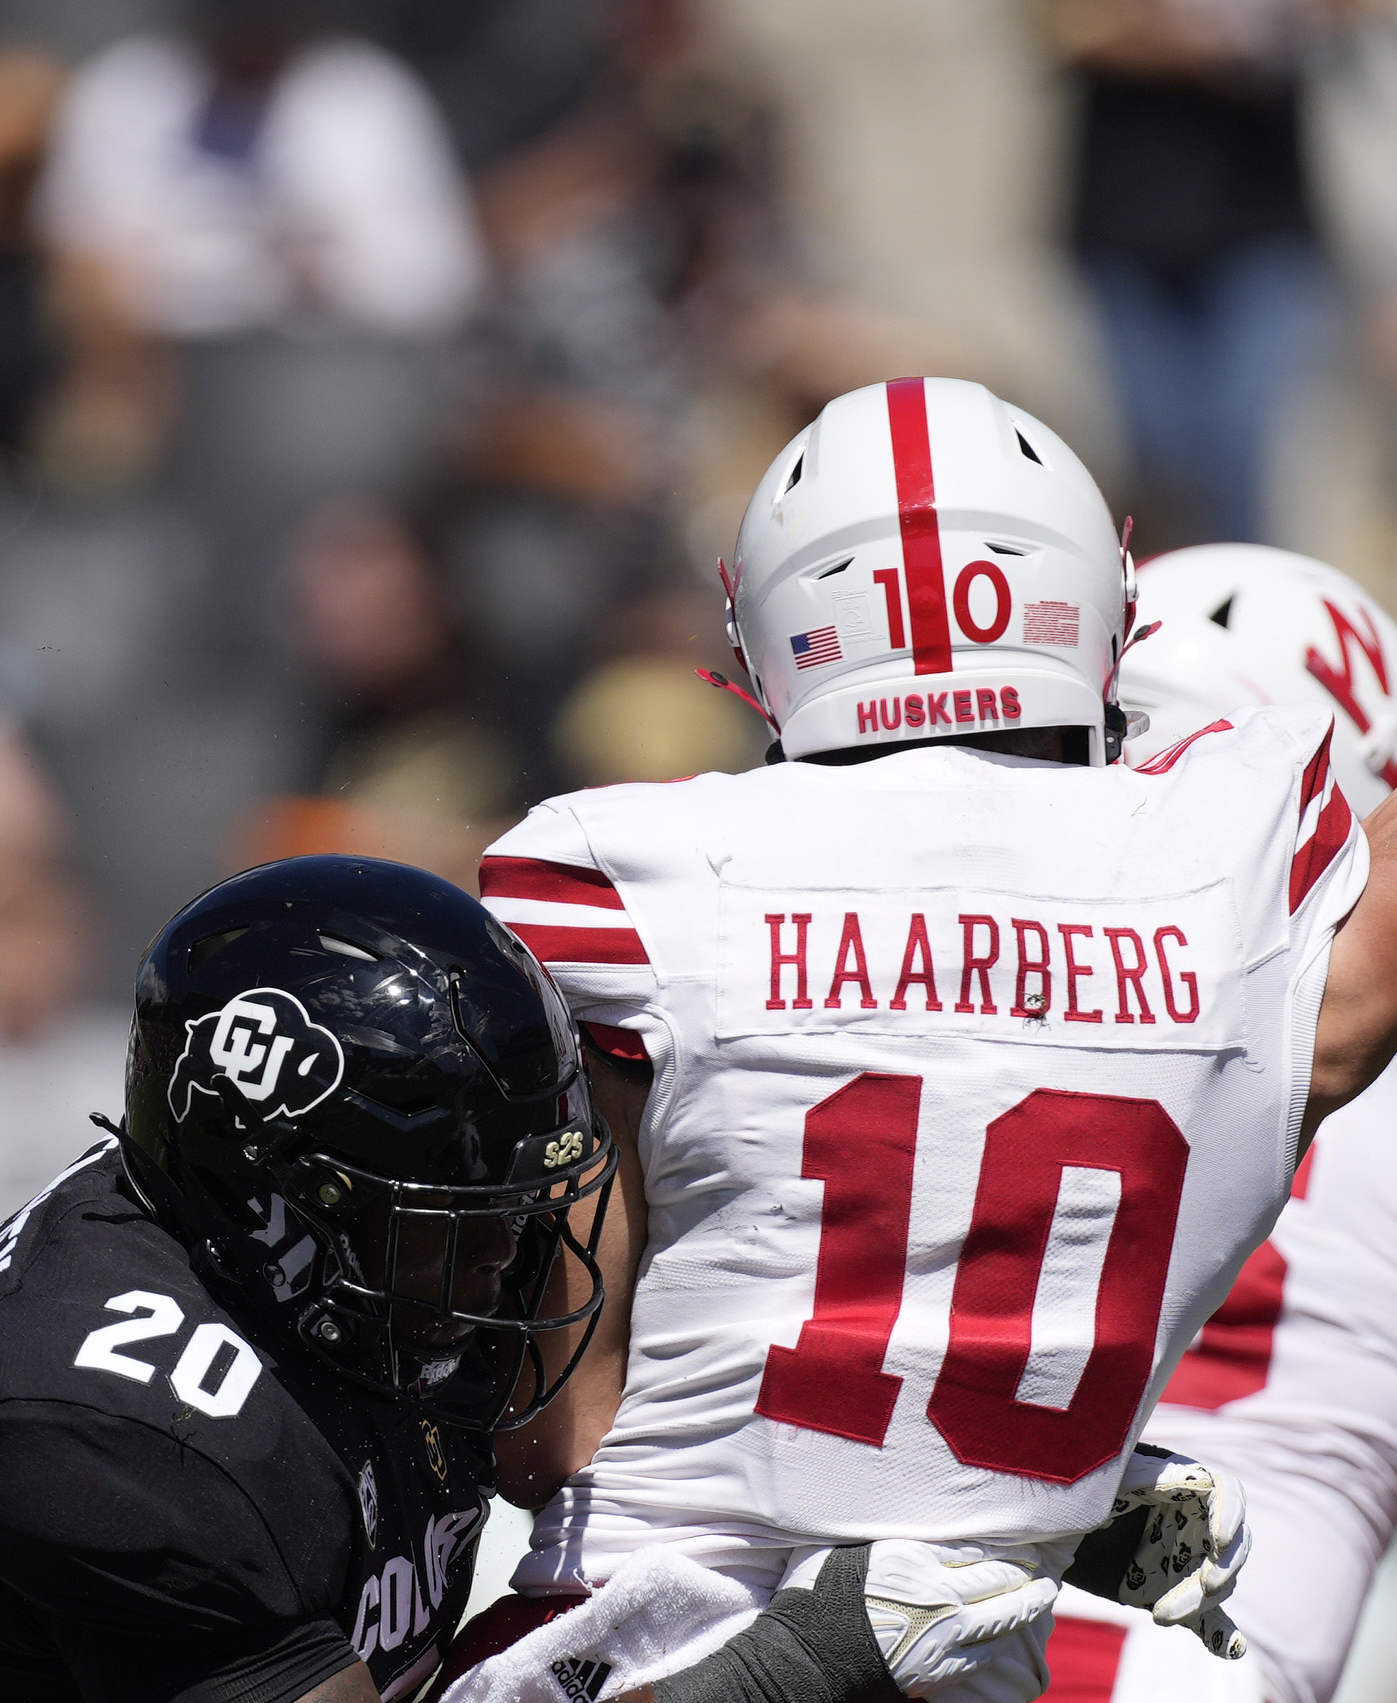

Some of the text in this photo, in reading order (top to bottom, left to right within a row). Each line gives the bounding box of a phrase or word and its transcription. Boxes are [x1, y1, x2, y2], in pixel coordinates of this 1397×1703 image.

[873, 560, 1012, 649] 10
[857, 686, 1022, 734] HUSKERS
[764, 911, 1201, 1024] HAARBERG
[754, 1071, 1191, 1487] 10
[73, 1289, 264, 1419] 20
